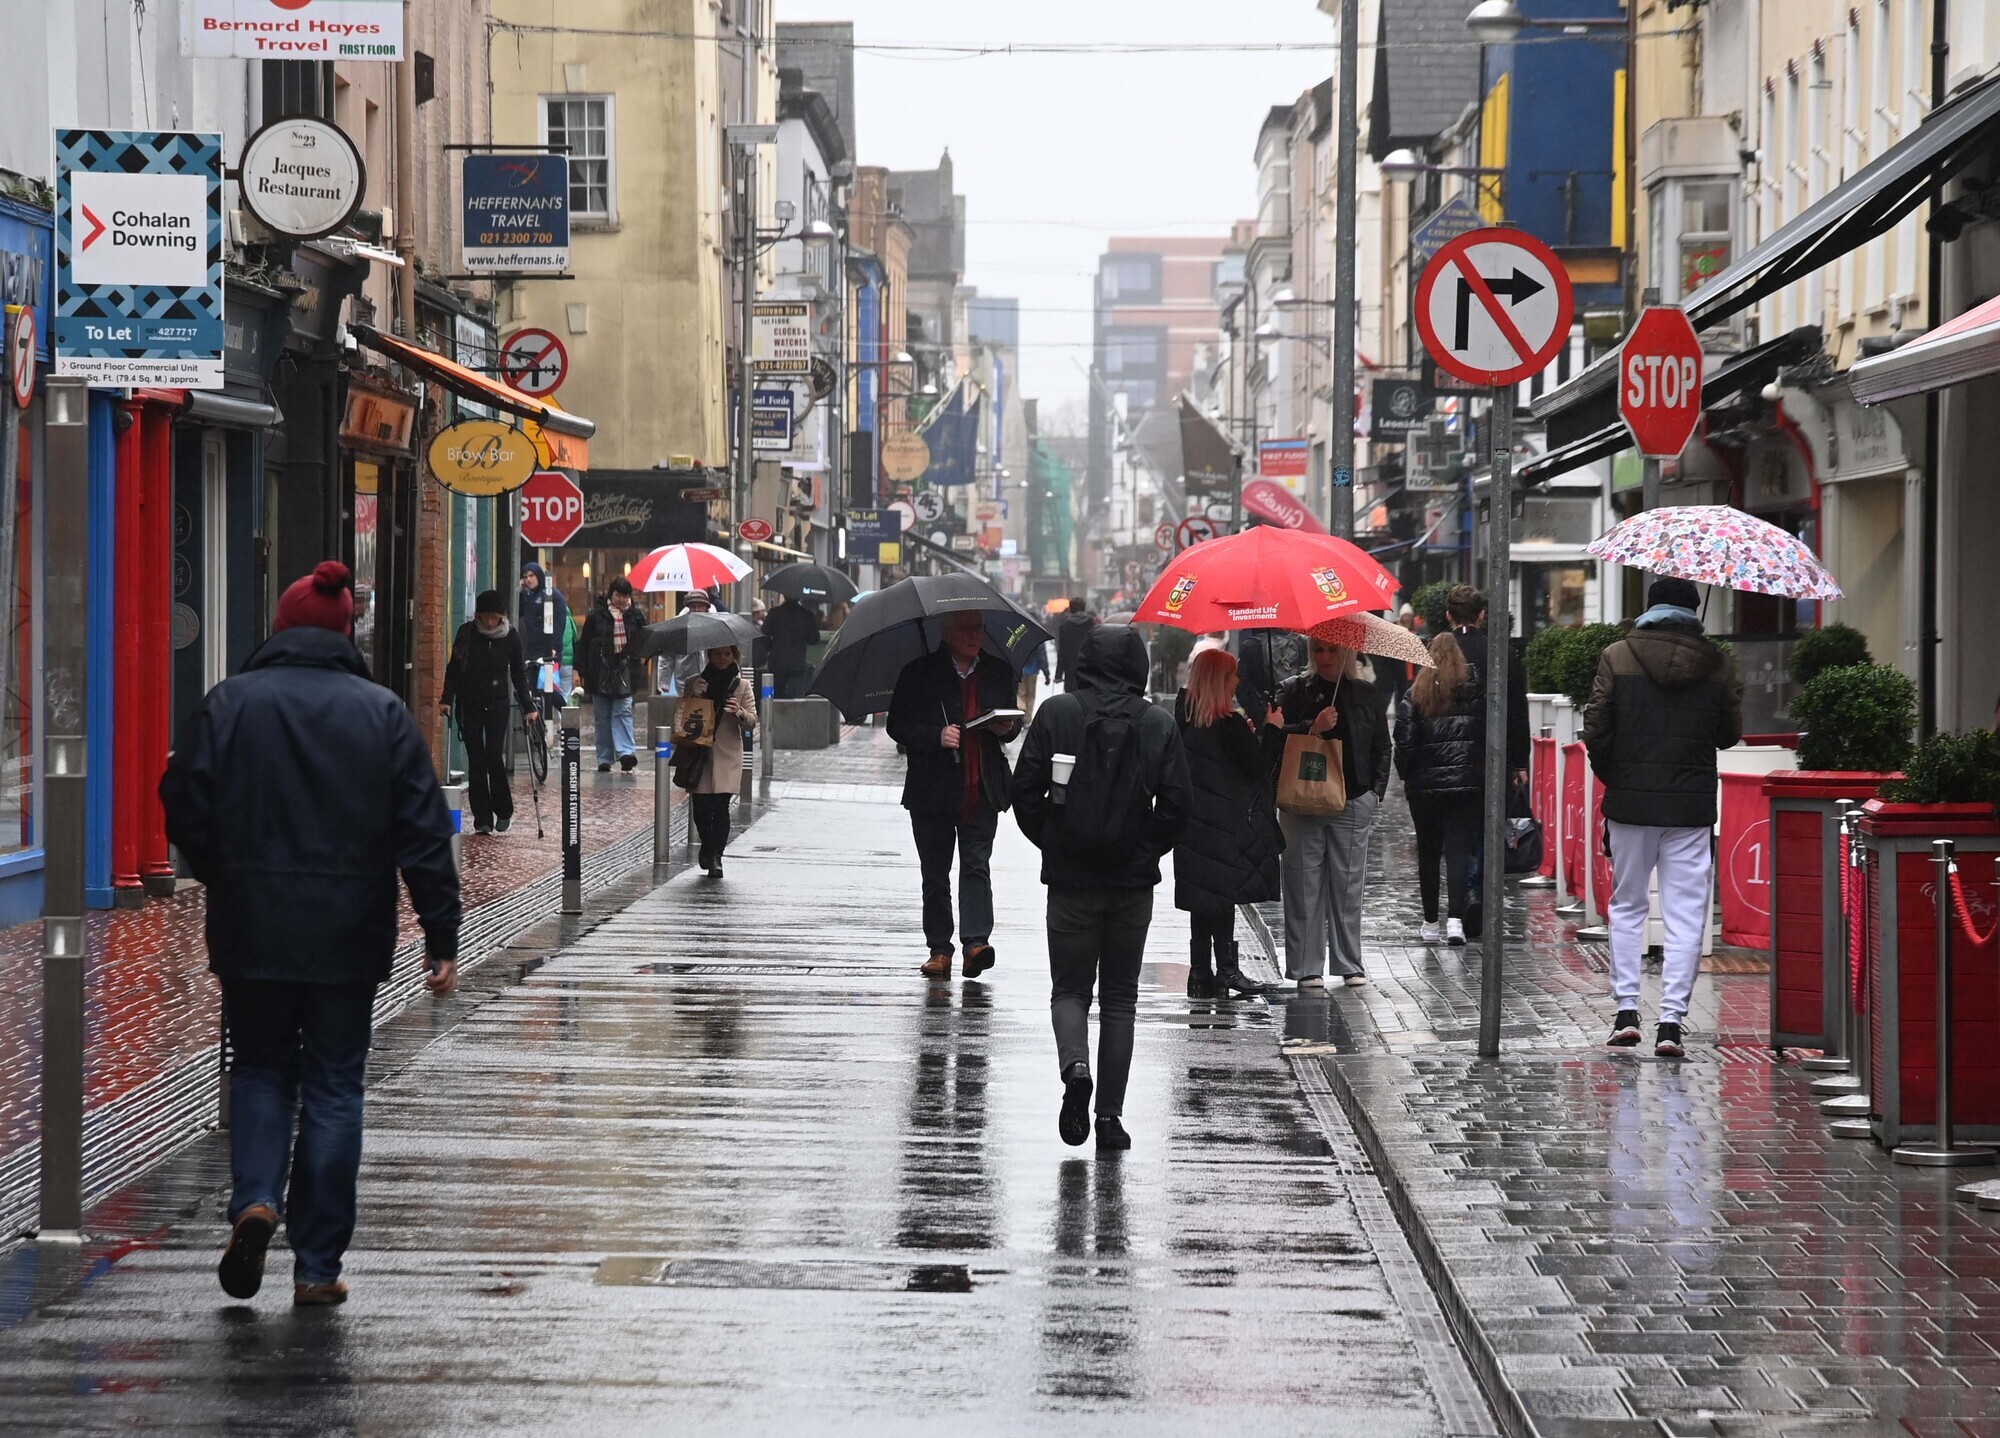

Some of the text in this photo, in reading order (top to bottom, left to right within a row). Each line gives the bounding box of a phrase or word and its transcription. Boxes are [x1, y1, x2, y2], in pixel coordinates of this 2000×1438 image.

[203, 17, 380, 37] Bernard Hayes
[255, 37, 328, 51] Travel
[339, 43, 396, 56] FIRST FLOOR
[272, 156, 331, 180] Jacques
[258, 176, 342, 200] Restaurant
[468, 196, 563, 210] HEFFERNAN'S
[112, 210, 191, 228] Cohalan
[490, 214, 541, 228] TRAVEL
[112, 230, 197, 252] Downing
[480, 232, 553, 244] 021 2300 700
[468, 253, 565, 266] www.heffernans.ie
[85, 325, 103, 340] To
[107, 325, 132, 341] Let
[773, 327, 801, 336] CLOCKS
[774, 338, 808, 347] WATCHES
[774, 349, 808, 358] REPAIRED
[69, 361, 198, 372] Ground Floor Commercial Unit
[87, 373, 101, 384] Sq.
[103, 374, 114, 382] Ft.
[116, 374, 136, 383] (79.4
[139, 374, 152, 385] Sq.
[155, 375, 168, 384] M.)
[169, 376, 202, 385] approx.
[1627, 354, 1697, 409] STOP
[447, 447, 515, 462] Brow Bar
[459, 472, 504, 486] Boutique
[1409, 478, 1434, 487] FLOO
[521, 496, 580, 521] STOP
[584, 504, 625, 521] ocolate
[863, 511, 878, 520] Let
[1228, 606, 1277, 616] Standard Life
[1232, 613, 1277, 621] Investments
[1304, 760, 1322, 770] M&S
[569, 761, 578, 847] CONSENT IS EVERYTHING.
